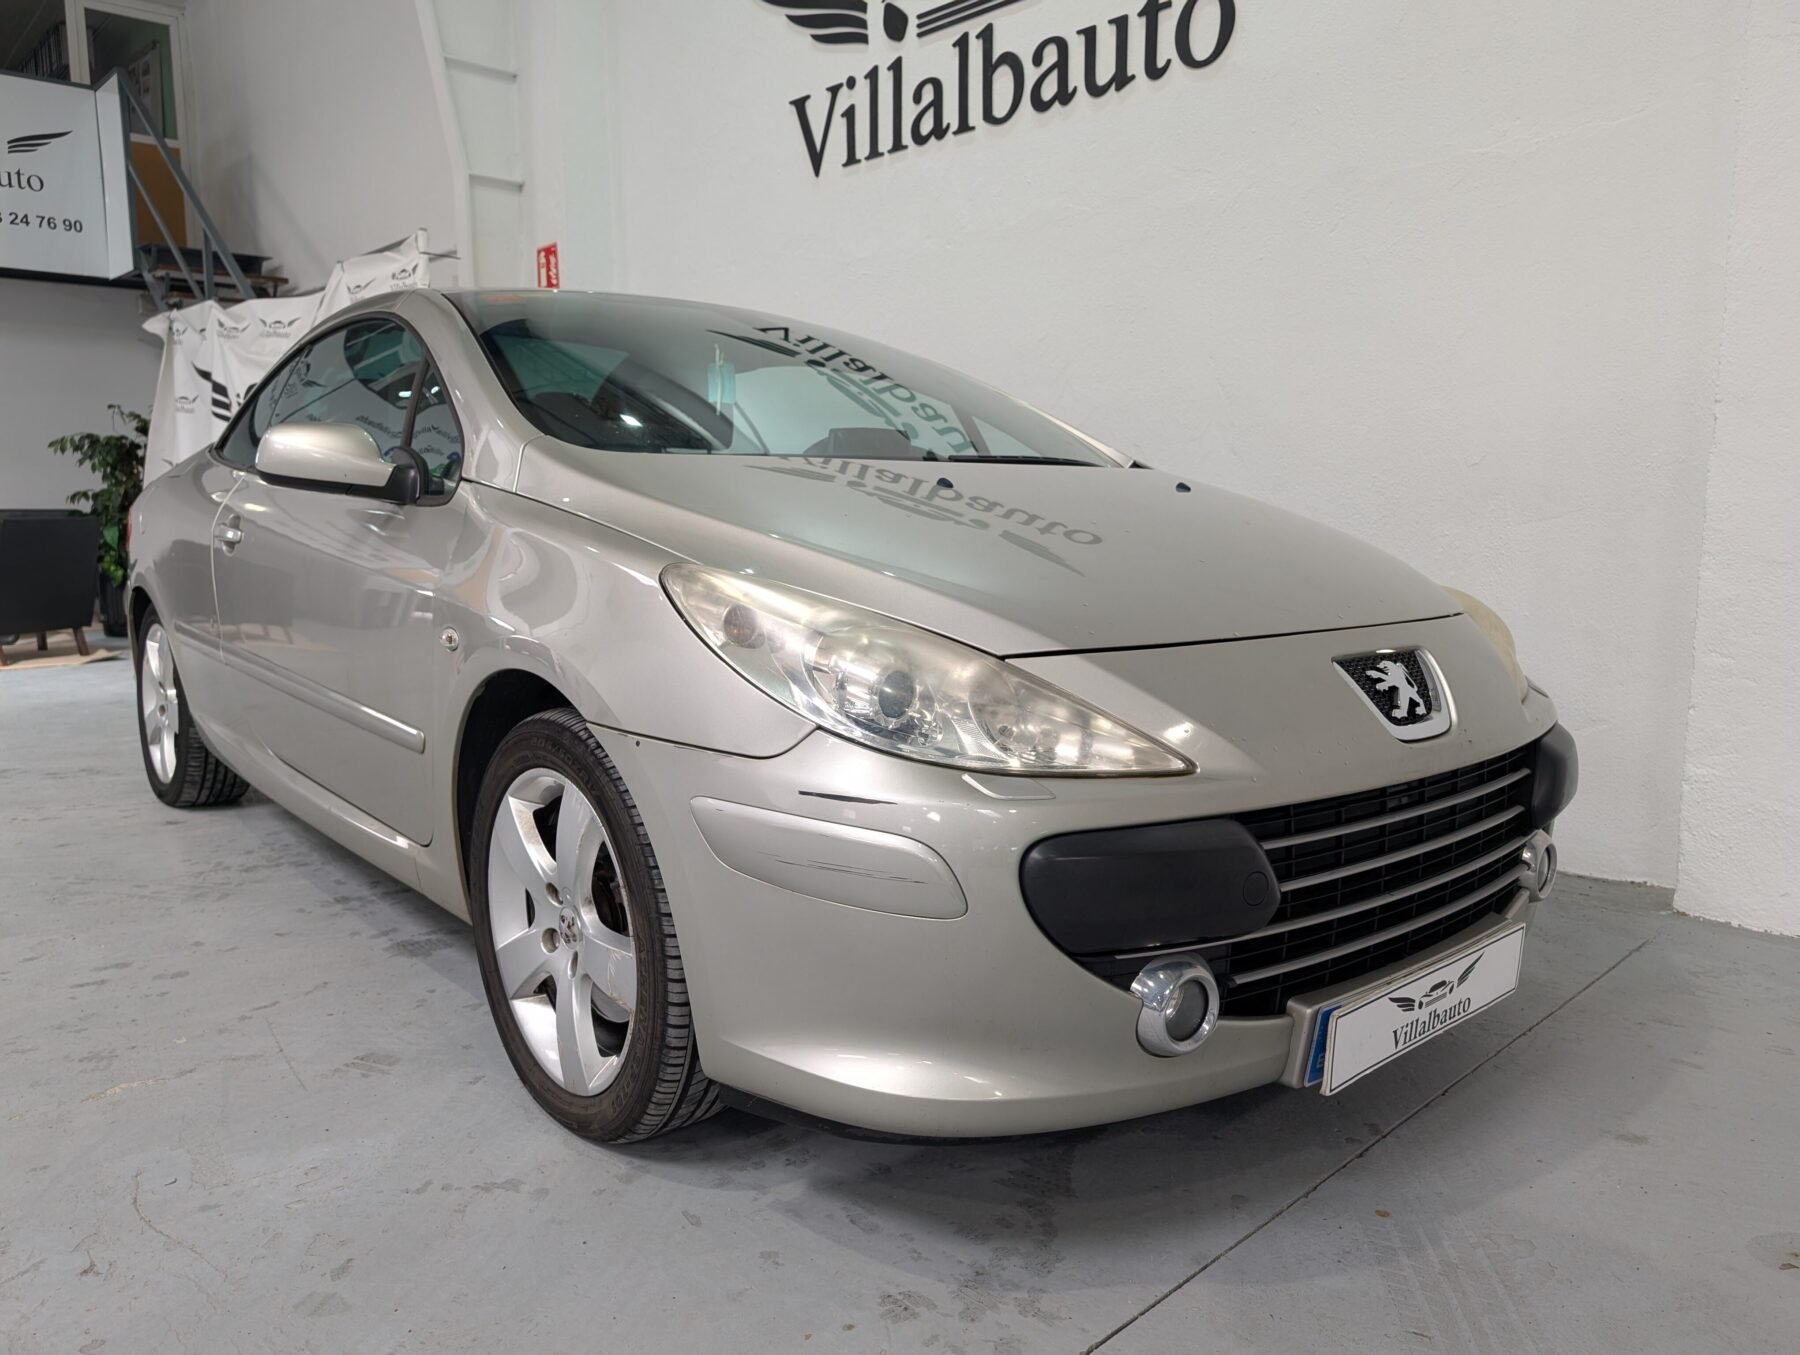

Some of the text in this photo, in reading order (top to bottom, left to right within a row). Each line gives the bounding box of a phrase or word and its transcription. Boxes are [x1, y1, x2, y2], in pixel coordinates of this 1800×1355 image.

[789, 0, 1236, 178] Villalbauto
[0, 168, 45, 192] uto
[8, 211, 31, 227] 24
[35, 214, 58, 230] 76
[62, 218, 83, 233] 90
[1392, 997, 1471, 1050] Villalbauto
